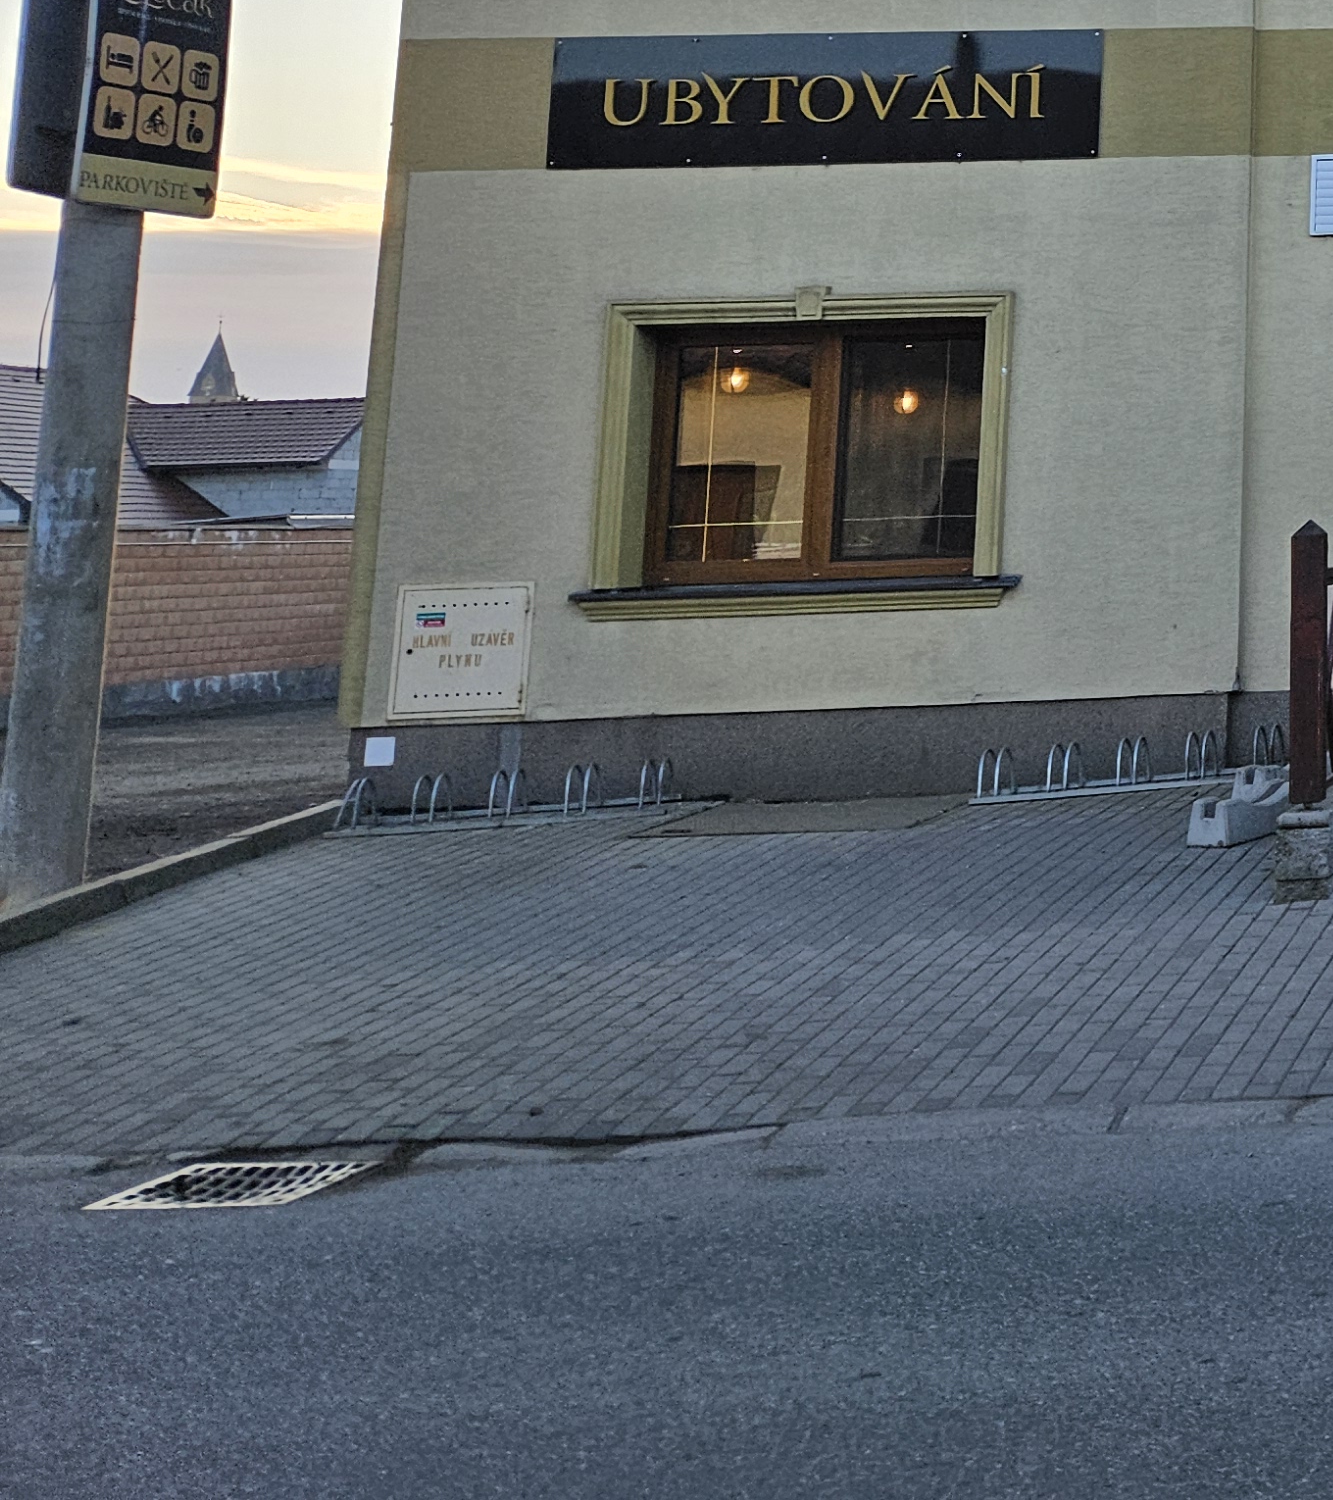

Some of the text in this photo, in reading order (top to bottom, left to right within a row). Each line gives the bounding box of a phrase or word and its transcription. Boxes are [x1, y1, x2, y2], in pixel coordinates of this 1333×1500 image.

[602, 64, 1047, 127] UBYTOVÁNÍ
[470, 629, 515, 647] UZÁVĚR
[438, 653, 483, 669] PLYNU
